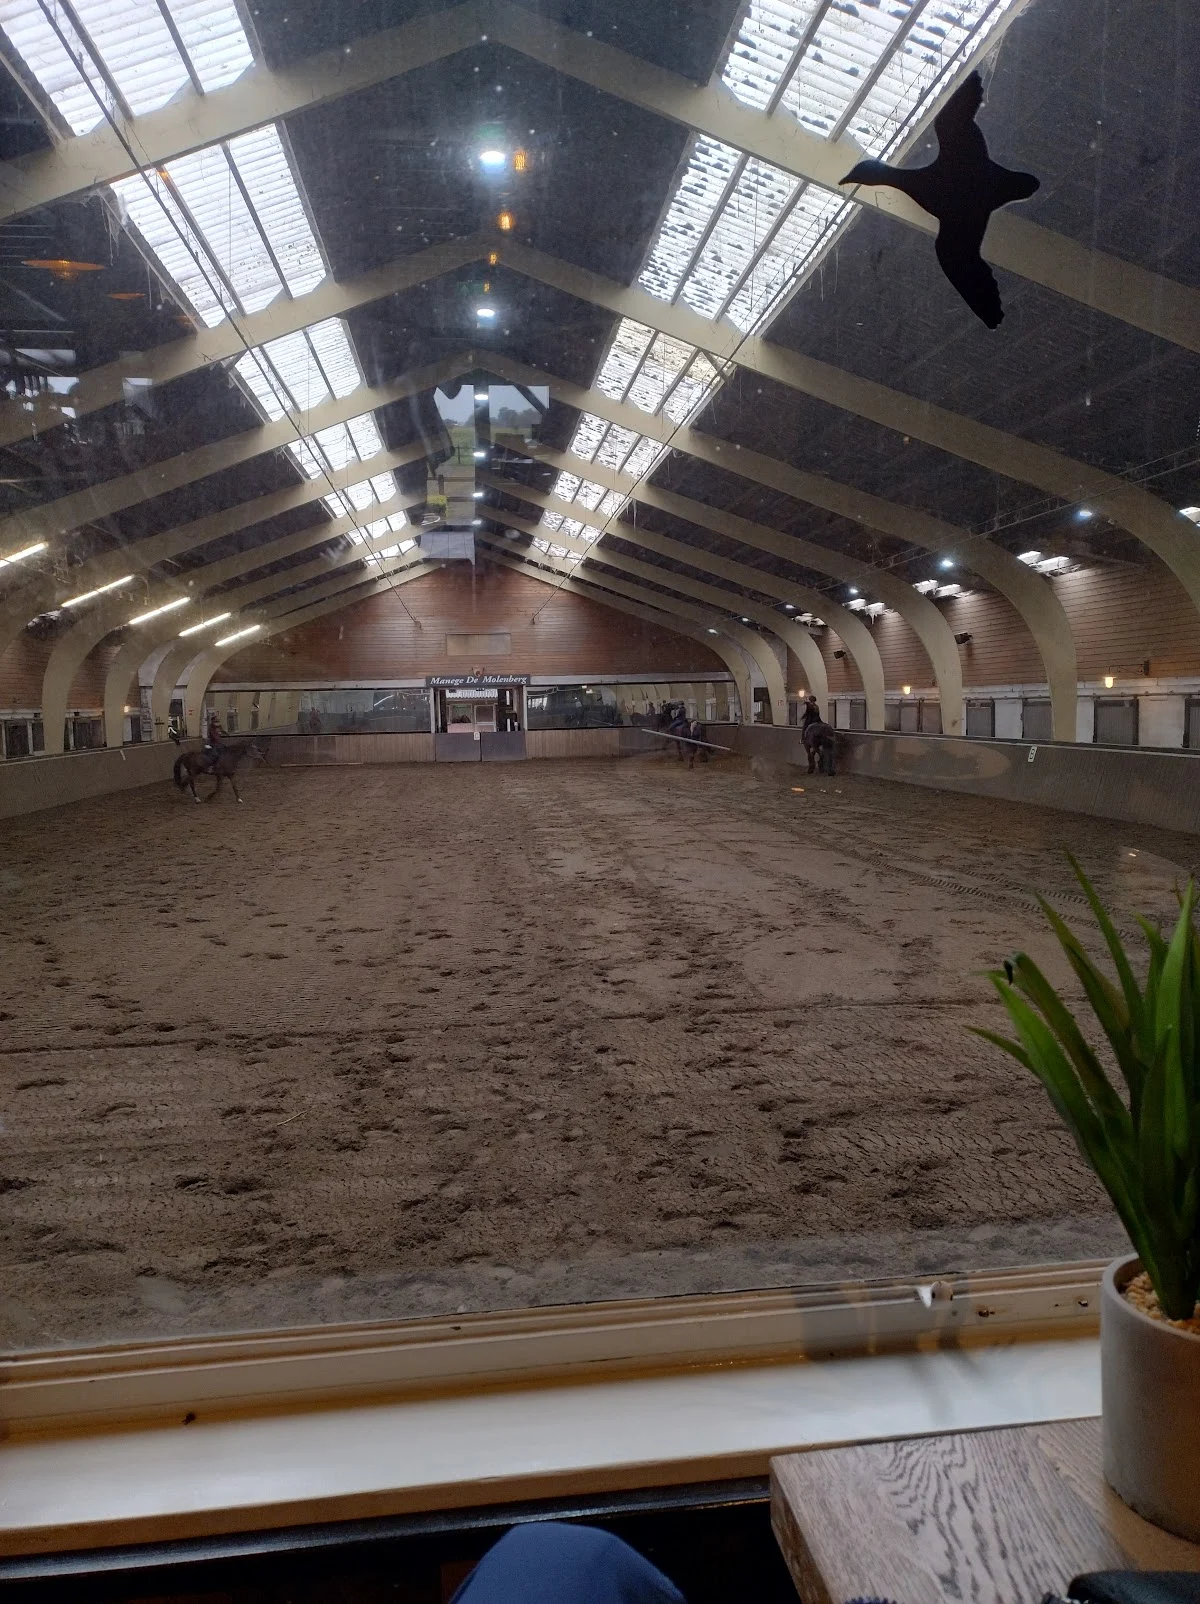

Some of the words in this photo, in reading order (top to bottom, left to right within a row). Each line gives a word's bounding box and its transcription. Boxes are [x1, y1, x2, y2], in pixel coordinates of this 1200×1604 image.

[430, 677, 464, 685] Manege
[466, 676, 479, 684] De
[482, 675, 527, 684] Molenberg
